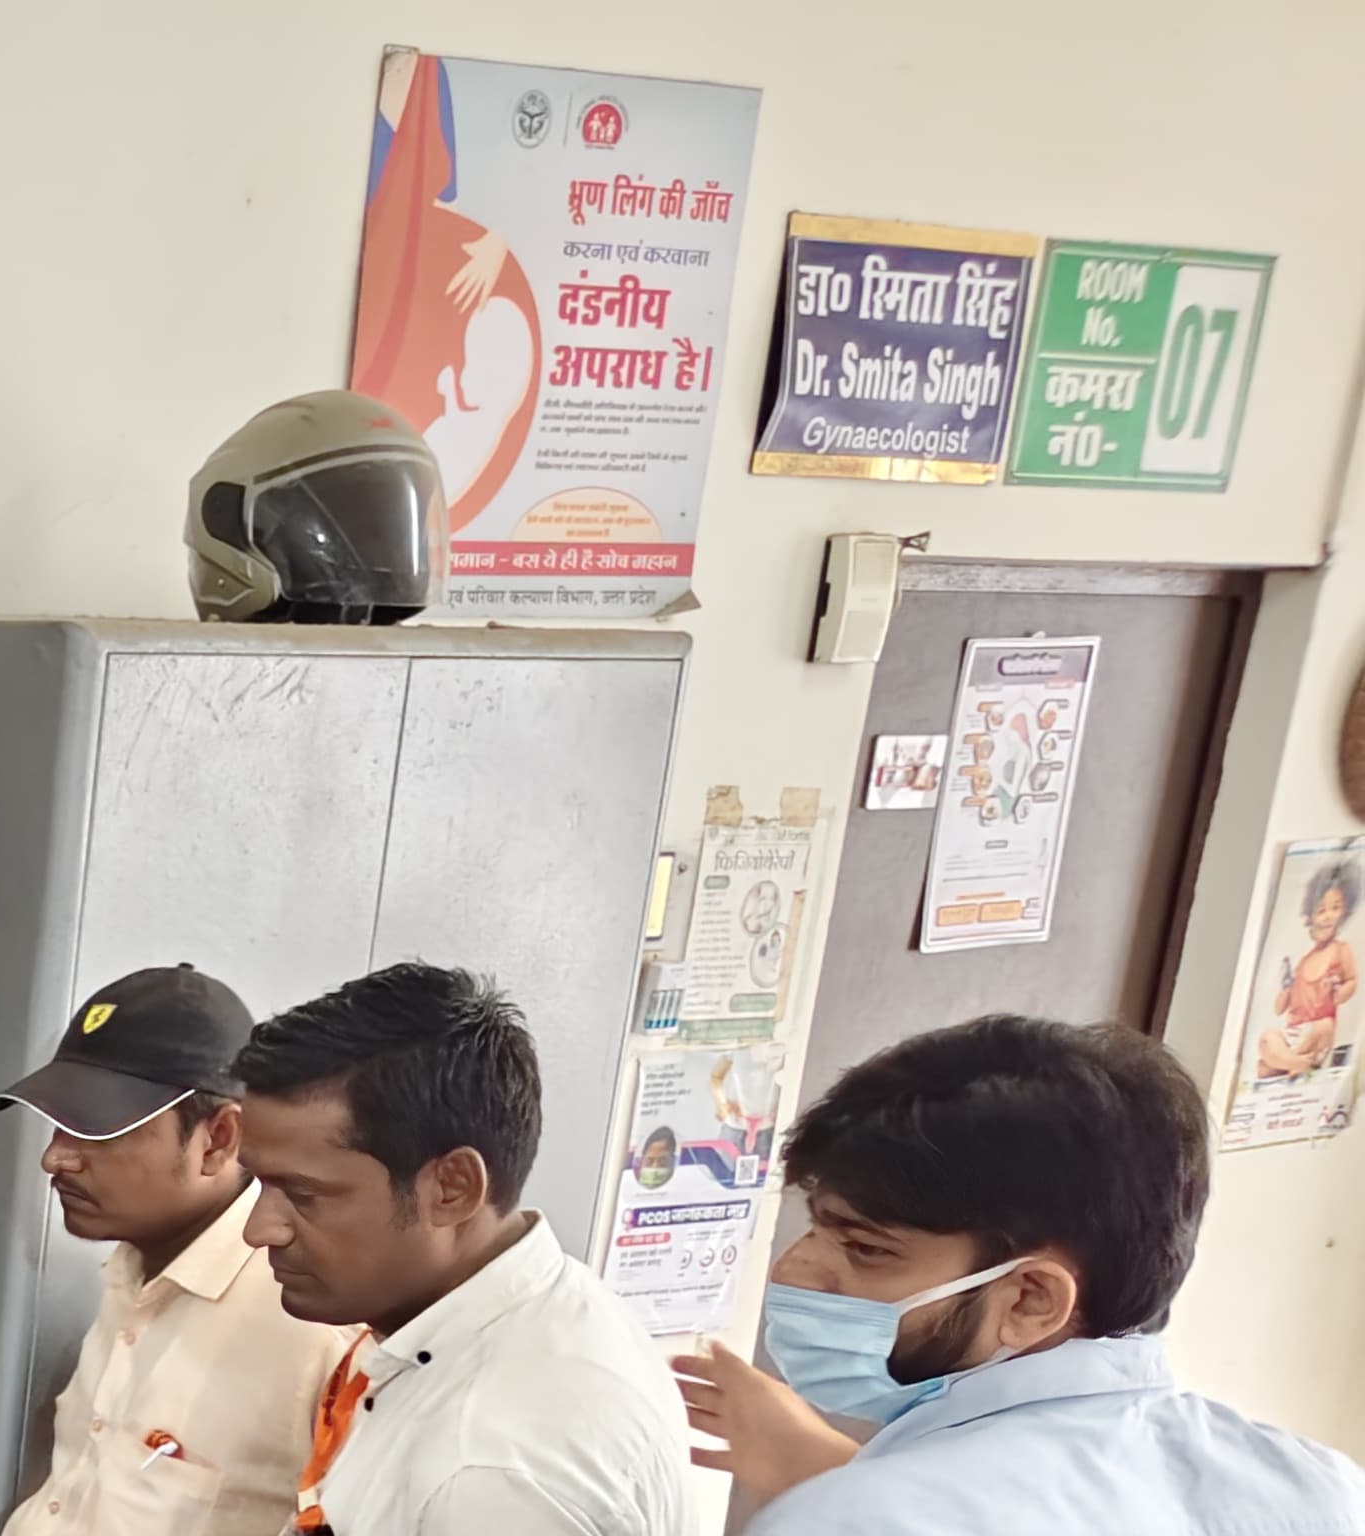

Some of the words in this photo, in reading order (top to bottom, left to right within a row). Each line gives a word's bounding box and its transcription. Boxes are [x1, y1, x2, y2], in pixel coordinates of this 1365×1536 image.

[568, 180, 607, 225] भ्रूण
[611, 174, 655, 218] लिंग
[659, 179, 686, 220] की
[563, 240, 612, 260] करना
[617, 240, 642, 264] एवं
[643, 245, 710, 267] करवाना
[558, 270, 671, 331] दंडनीय
[859, 254, 951, 324] स्मिता
[953, 261, 1017, 339] सिंह
[1077, 259, 1149, 304] ROOM
[1081, 305, 1122, 347] No.
[549, 345, 667, 391] अपराध
[794, 339, 830, 399] Dr.
[839, 341, 917, 403] Smita
[924, 344, 1002, 419] Singh
[1045, 366, 1143, 411] कमरा
[1158, 304, 1239, 440] 07
[803, 416, 970, 459] Gynaecologist
[512, 551, 539, 569] बस
[543, 549, 557, 569] ये
[560, 548, 578, 570] ही
[581, 549, 595, 570] है
[596, 549, 629, 569] सोच
[631, 553, 677, 570] महान
[467, 585, 505, 604] परिवार
[509, 589, 553, 605] कल्याण
[628, 584, 657, 605] प्रदेश
[638, 1210, 671, 1226] PCOS
